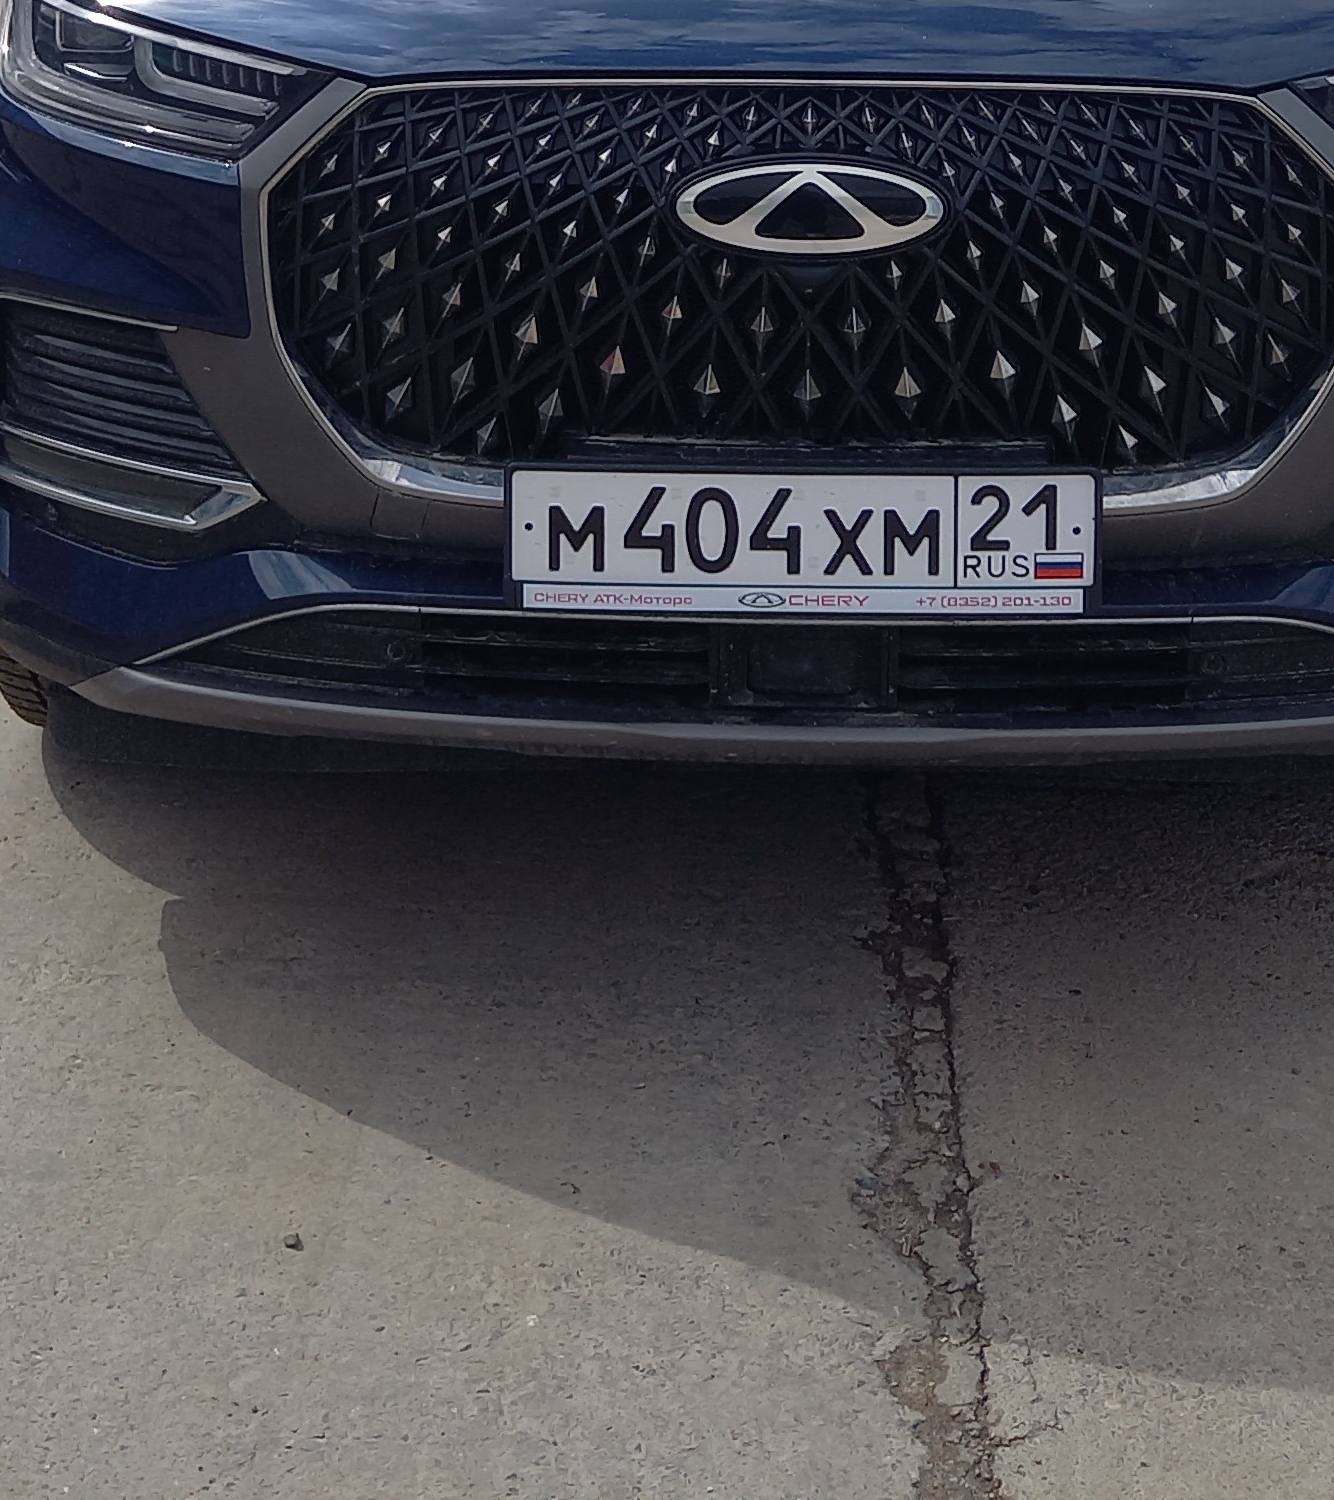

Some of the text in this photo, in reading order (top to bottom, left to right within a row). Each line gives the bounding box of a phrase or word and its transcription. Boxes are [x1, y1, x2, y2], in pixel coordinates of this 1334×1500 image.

[549, 484, 1058, 576] М404ХМ 21
[963, 555, 1030, 578] RUS
[534, 592, 589, 604] CHERY
[788, 594, 869, 607] CHERY
[916, 595, 1072, 608] +7 (8352) 201-130
